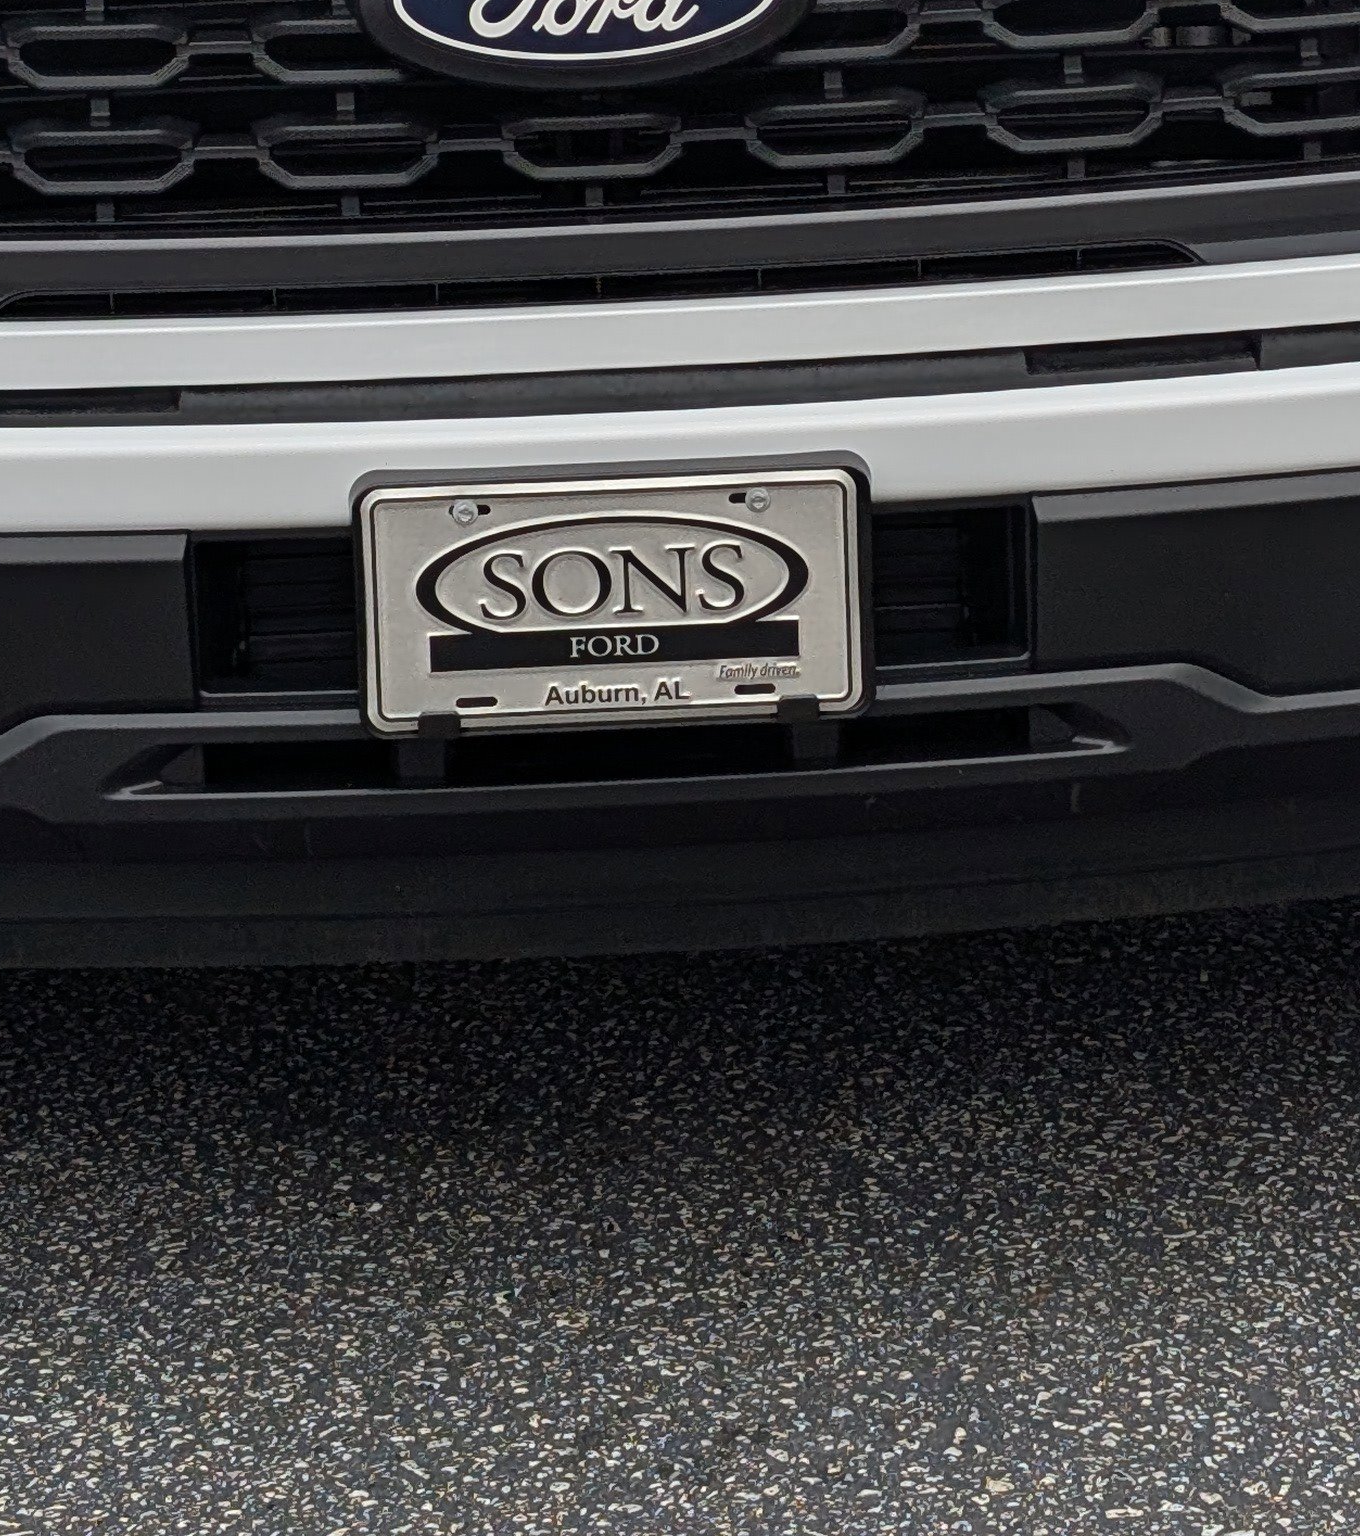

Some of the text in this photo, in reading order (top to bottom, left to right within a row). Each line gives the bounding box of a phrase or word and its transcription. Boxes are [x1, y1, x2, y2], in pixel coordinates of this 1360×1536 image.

[478, 543, 745, 621] SONS
[569, 634, 660, 658] FORD
[719, 665, 758, 680] Family
[544, 681, 691, 706] Auburn, AL
